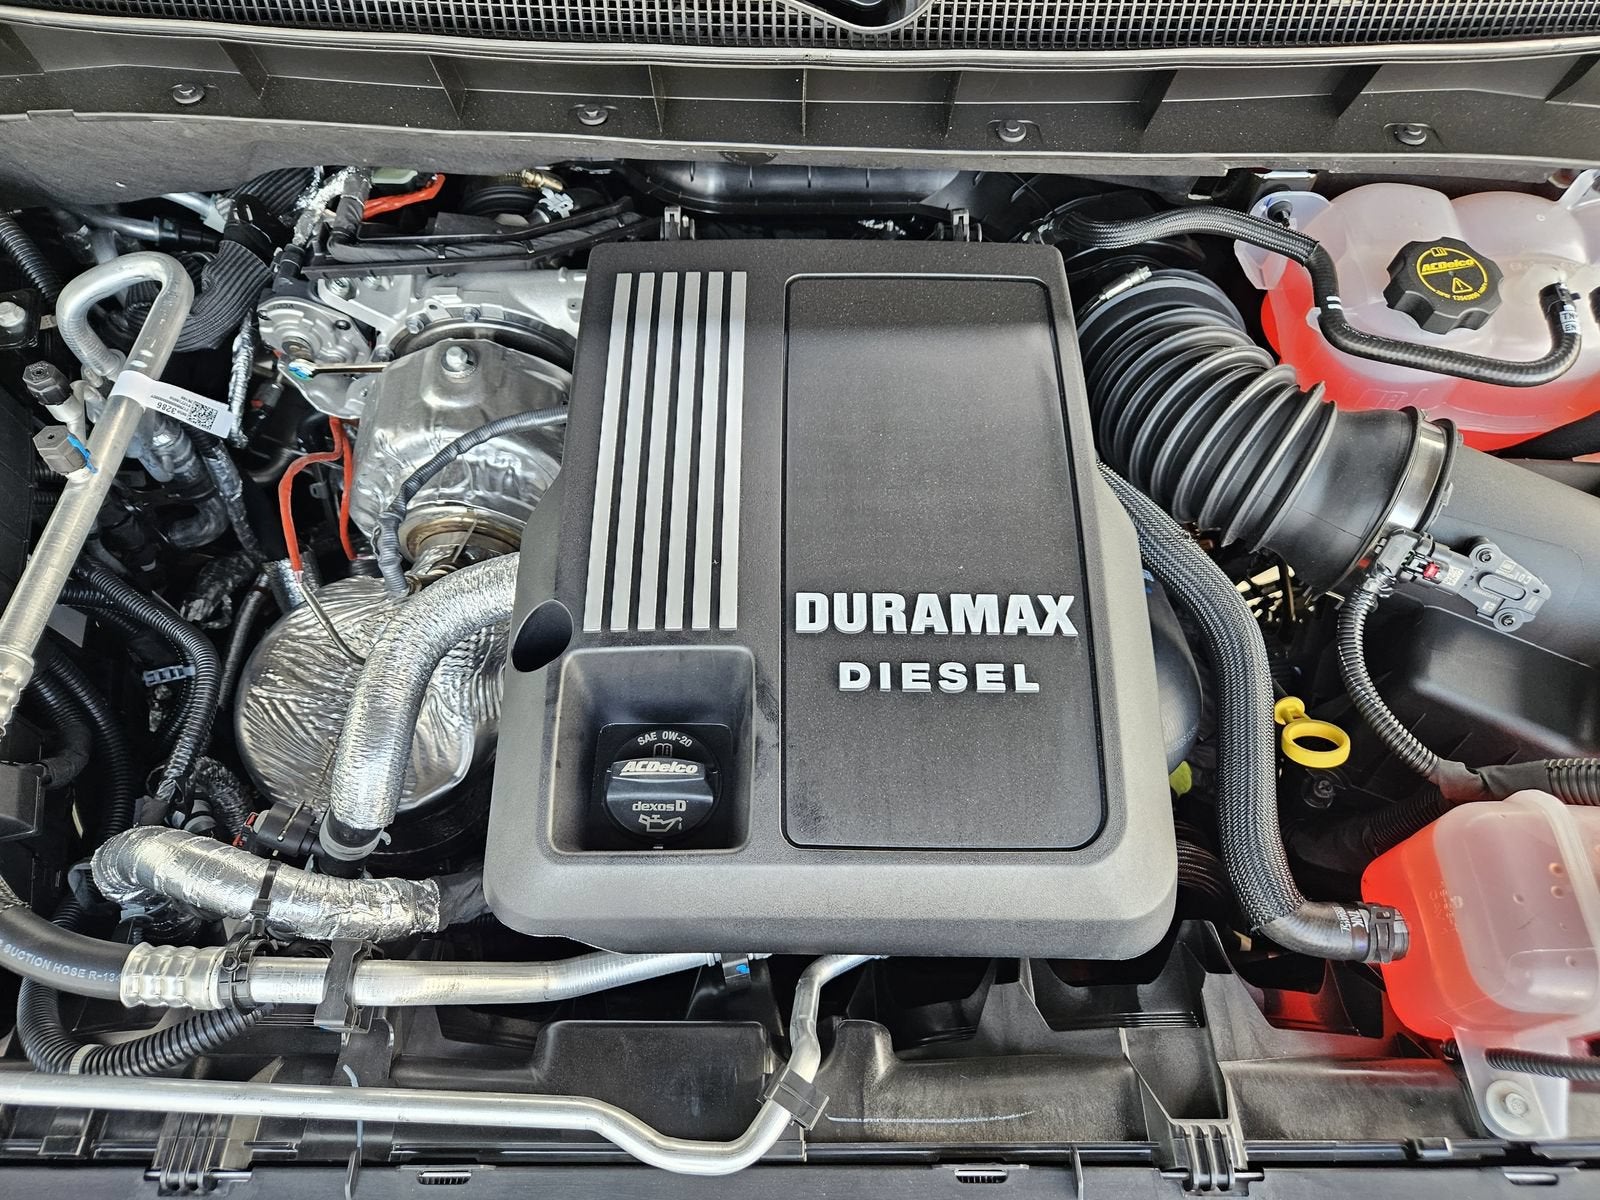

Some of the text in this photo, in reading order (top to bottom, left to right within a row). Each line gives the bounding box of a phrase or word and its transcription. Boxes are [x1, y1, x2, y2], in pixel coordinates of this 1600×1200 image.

[1421, 258, 1475, 273] ACDelco
[156, 402, 177, 415] 3286
[795, 592, 1079, 637] DURAMAX
[839, 661, 1040, 694] DIESEL
[637, 730, 693, 748] SAE 0W-20
[621, 760, 699, 775] ACDelco
[5, 944, 51, 970] SUCTION
[52, 962, 86, 979] HOSE
